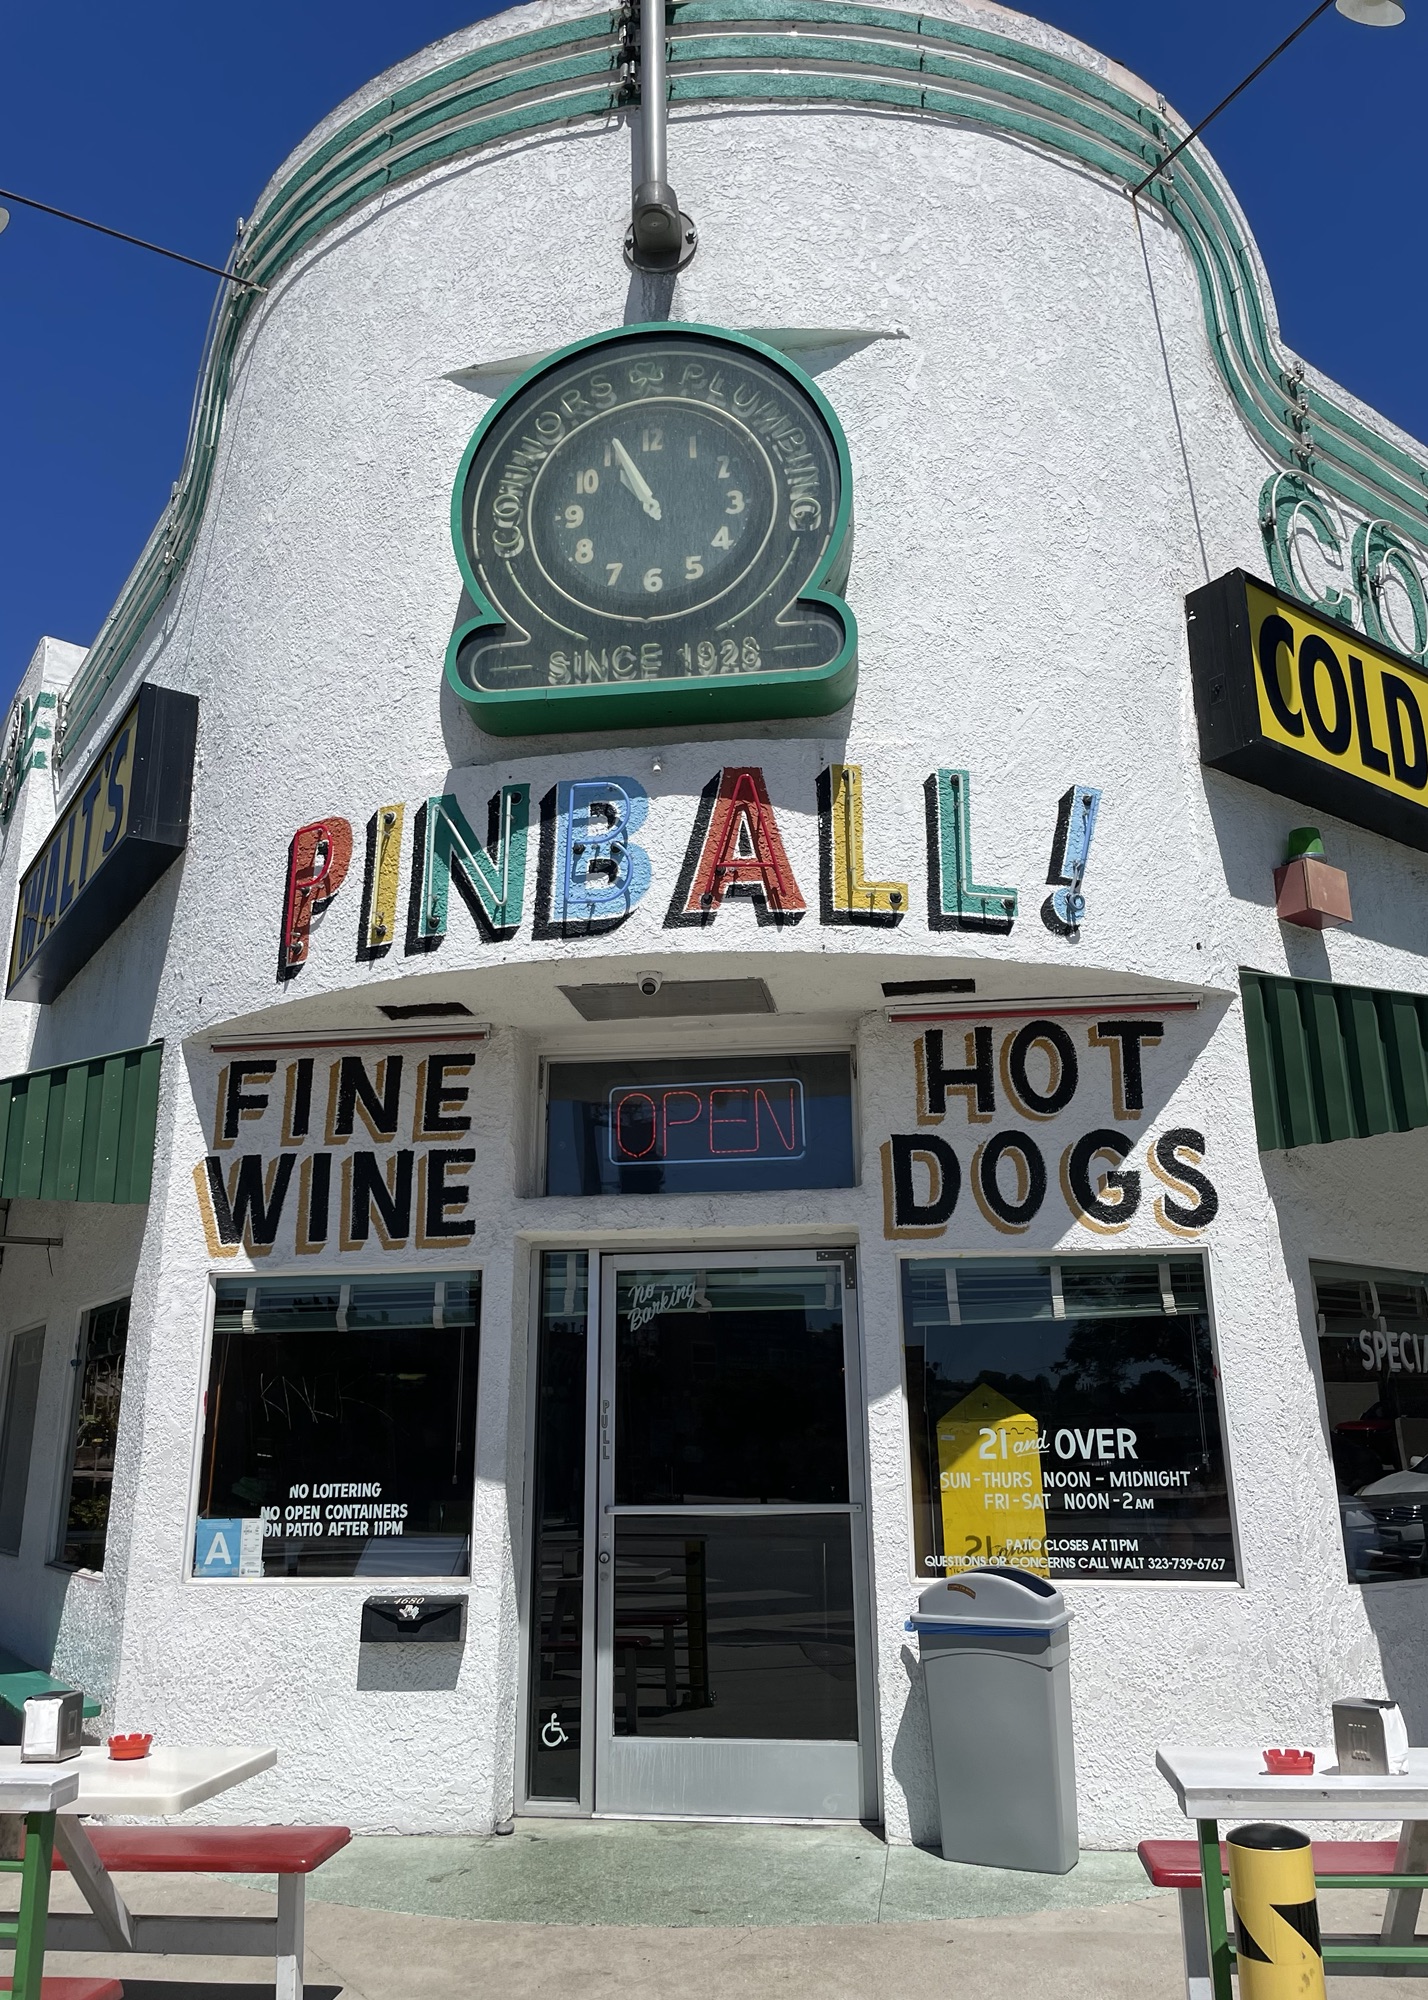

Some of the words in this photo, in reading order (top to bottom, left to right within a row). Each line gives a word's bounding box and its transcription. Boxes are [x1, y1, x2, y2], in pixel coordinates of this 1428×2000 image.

[642, 429, 663, 451] 12
[679, 363, 821, 531] PLUMBING
[689, 436, 697, 459] 1
[492, 374, 618, 558] CONNORS
[716, 455, 731, 479] 2
[576, 468, 599, 494] 10
[725, 490, 745, 515] 3
[564, 504, 584, 529] 9
[574, 538, 594, 564] 8
[710, 526, 734, 550] 4
[605, 562, 623, 586] 7
[643, 568, 663, 592] 6
[684, 555, 704, 580] 5
[548, 643, 664, 686] SINCE
[677, 636, 762, 677] 1928
[1259, 614, 1428, 790] COLD
[18, 728, 131, 970] WALT'S
[277, 766, 1102, 981] PINBALL!
[913, 1020, 1164, 1125] HOT
[214, 1052, 476, 1149] FINE
[616, 1088, 796, 1159] OPEN
[879, 1127, 1219, 1241] DOGS
[194, 1148, 476, 1257] WINE
[627, 1281, 698, 1332] Barking
[601, 1399, 610, 1460] PULL
[978, 1427, 1008, 1460] 21
[1013, 1430, 1050, 1457] and
[1054, 1428, 1138, 1460] OVER
[289, 1484, 309, 1499] NO
[312, 1482, 382, 1499] LOITERING
[1043, 1471, 1091, 1488] NOON
[1109, 1470, 1191, 1487] MIDNIGHT
[260, 1506, 280, 1521] NO
[285, 1505, 320, 1521] OPEN
[325, 1503, 409, 1520] CONTAINERS
[262, 1521, 282, 1537] ON
[285, 1521, 324, 1537] PATIO
[327, 1521, 369, 1537] AFTER
[203, 1531, 232, 1565] A
[1005, 1538, 1042, 1551] PATIO
[1044, 1538, 1089, 1552] CLOSES
[1091, 1539, 1107, 1552] AT
[924, 1555, 986, 1568] QUESTIONS
[988, 1555, 1008, 1568] OR
[1010, 1556, 1076, 1569] CONCERNS
[1078, 1557, 1109, 1570] CALL
[1111, 1557, 1145, 1569] WALT
[1147, 1557, 1226, 1571] 323-739-6767
[393, 1597, 425, 1605] 4680
